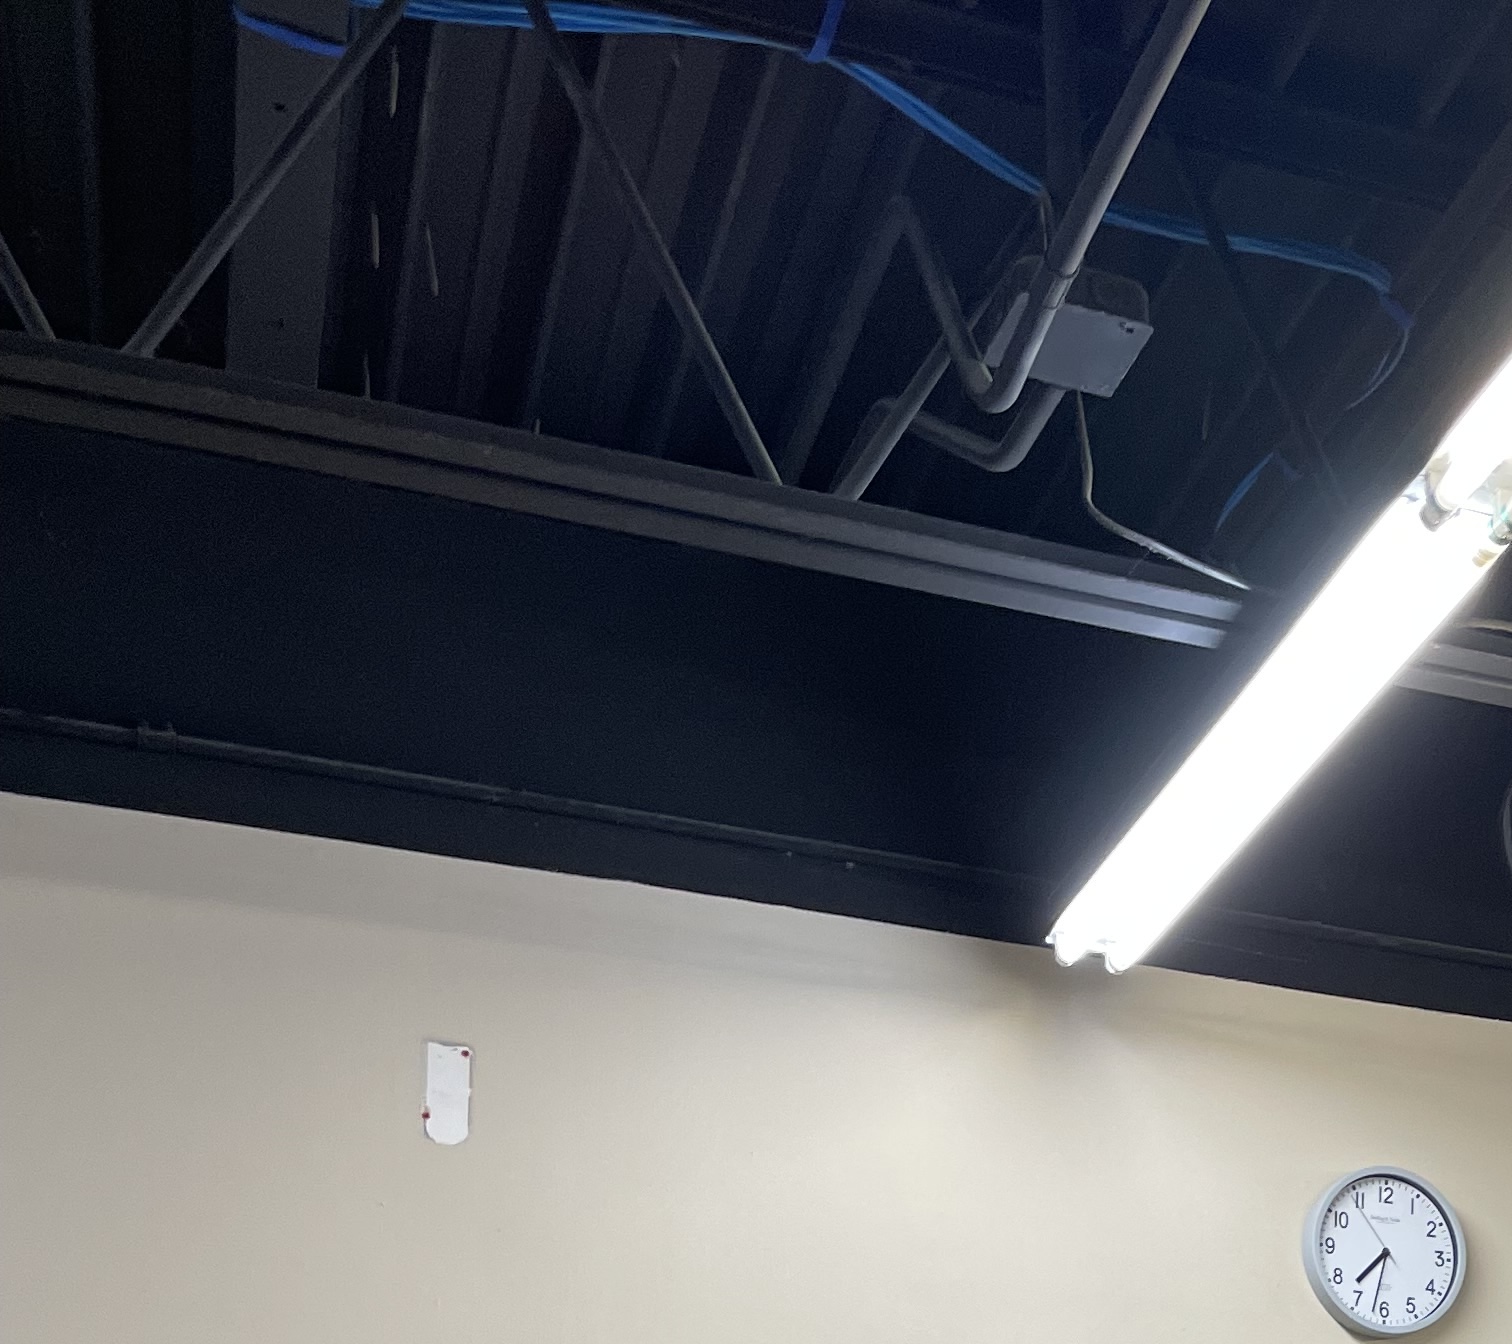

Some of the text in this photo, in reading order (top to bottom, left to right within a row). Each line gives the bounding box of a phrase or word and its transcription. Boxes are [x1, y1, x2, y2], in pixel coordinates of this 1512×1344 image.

[1356, 1192, 1364, 1209] 11
[1379, 1186, 1393, 1204] 12
[1335, 1211, 1349, 1228] 10
[1426, 1221, 1437, 1237] 2
[1325, 1238, 1335, 1254] 9
[1435, 1251, 1444, 1267] 3
[1333, 1268, 1342, 1284] 8
[1425, 1279, 1435, 1294] 4
[1353, 1290, 1363, 1306] 7
[1406, 1297, 1415, 1313] 5
[1380, 1302, 1389, 1318] 6
